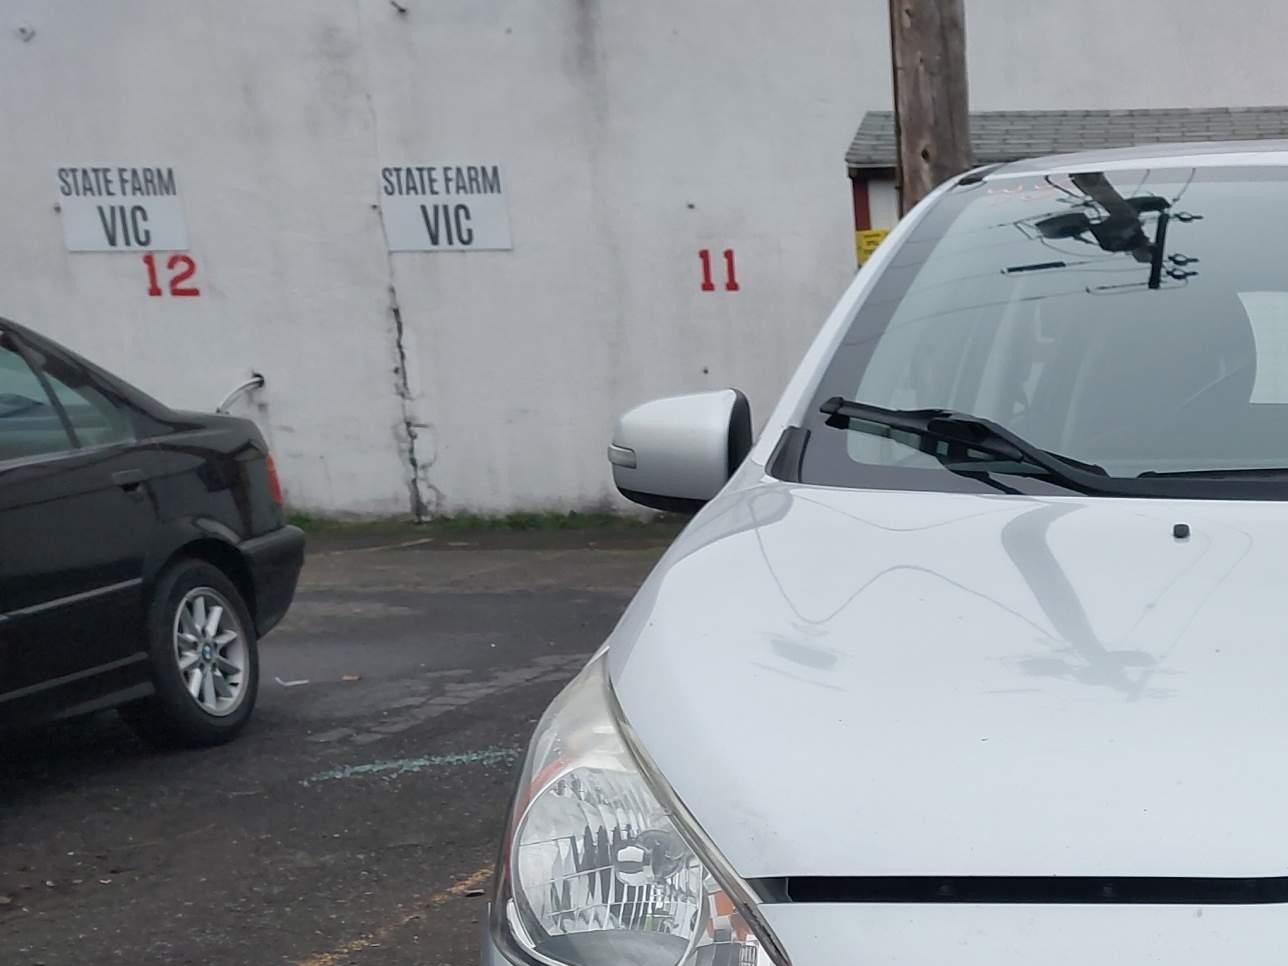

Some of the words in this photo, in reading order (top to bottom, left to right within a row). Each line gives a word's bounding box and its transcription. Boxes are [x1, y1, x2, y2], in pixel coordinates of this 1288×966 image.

[58, 167, 116, 197] STATE
[118, 167, 177, 197] FARM
[382, 166, 439, 196] STATE
[443, 165, 502, 195] FARM
[97, 205, 151, 247] VIC
[420, 204, 474, 246] VIC
[143, 255, 199, 297] 12
[698, 249, 738, 292] 11
